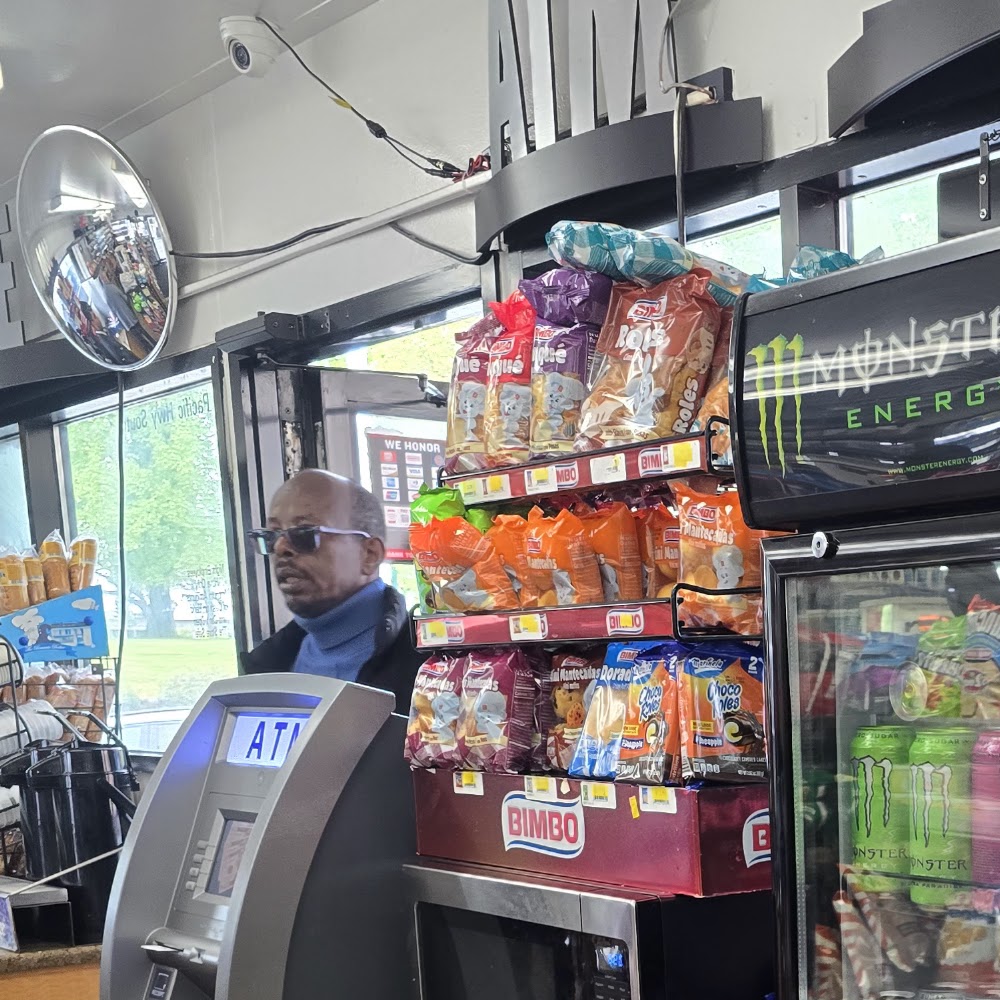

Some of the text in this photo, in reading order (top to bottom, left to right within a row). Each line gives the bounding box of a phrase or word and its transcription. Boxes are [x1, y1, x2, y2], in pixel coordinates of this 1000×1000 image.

[672, 376, 699, 434] Roles
[385, 440, 441, 454] WE HONOR
[641, 456, 662, 470] BIM
[887, 455, 984, 475] WWW.MONSTERENERGY.COM
[556, 468, 577, 482] MBO
[748, 656, 757, 671] 2
[707, 680, 741, 700] Choco
[508, 807, 578, 843] BIMBO
[853, 846, 909, 859] ONSTER
[911, 857, 968, 871] ONSTER
